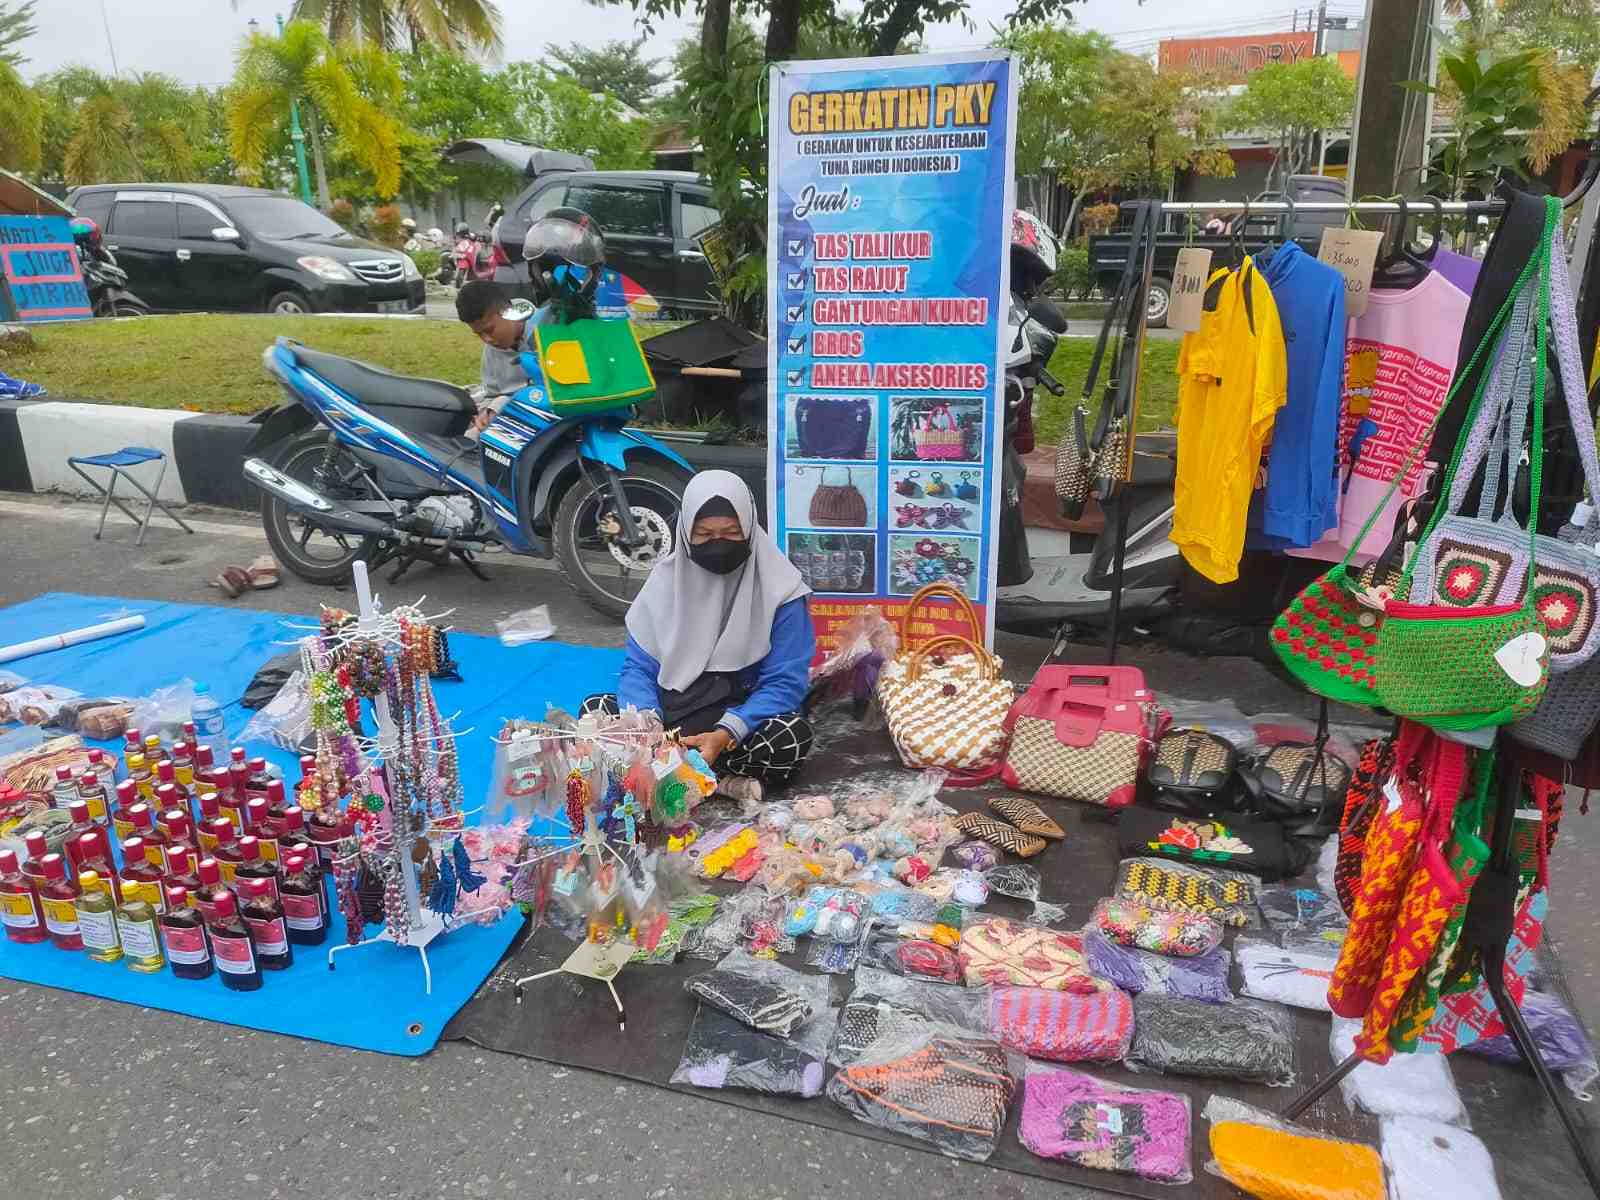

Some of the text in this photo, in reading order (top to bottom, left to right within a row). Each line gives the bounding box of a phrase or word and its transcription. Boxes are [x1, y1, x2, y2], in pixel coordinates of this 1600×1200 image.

[789, 82, 995, 134] GERKATIN PKY
[804, 138, 853, 154] GERAKAN
[856, 136, 892, 152] UNTUK
[822, 160, 849, 175] TUNA
[852, 158, 889, 175] RUNGU
[892, 156, 951, 173] INDONESIA
[794, 185, 848, 218] Jual
[815, 233, 931, 257] TAS TALI KUR
[815, 267, 908, 291] TAS RAJUT
[814, 299, 988, 323] GANTUNGAN KUNCI
[813, 331, 863, 355] BROS
[812, 364, 986, 388] ANEKA AKSESORIES
[484, 447, 511, 467] YAMAHA
